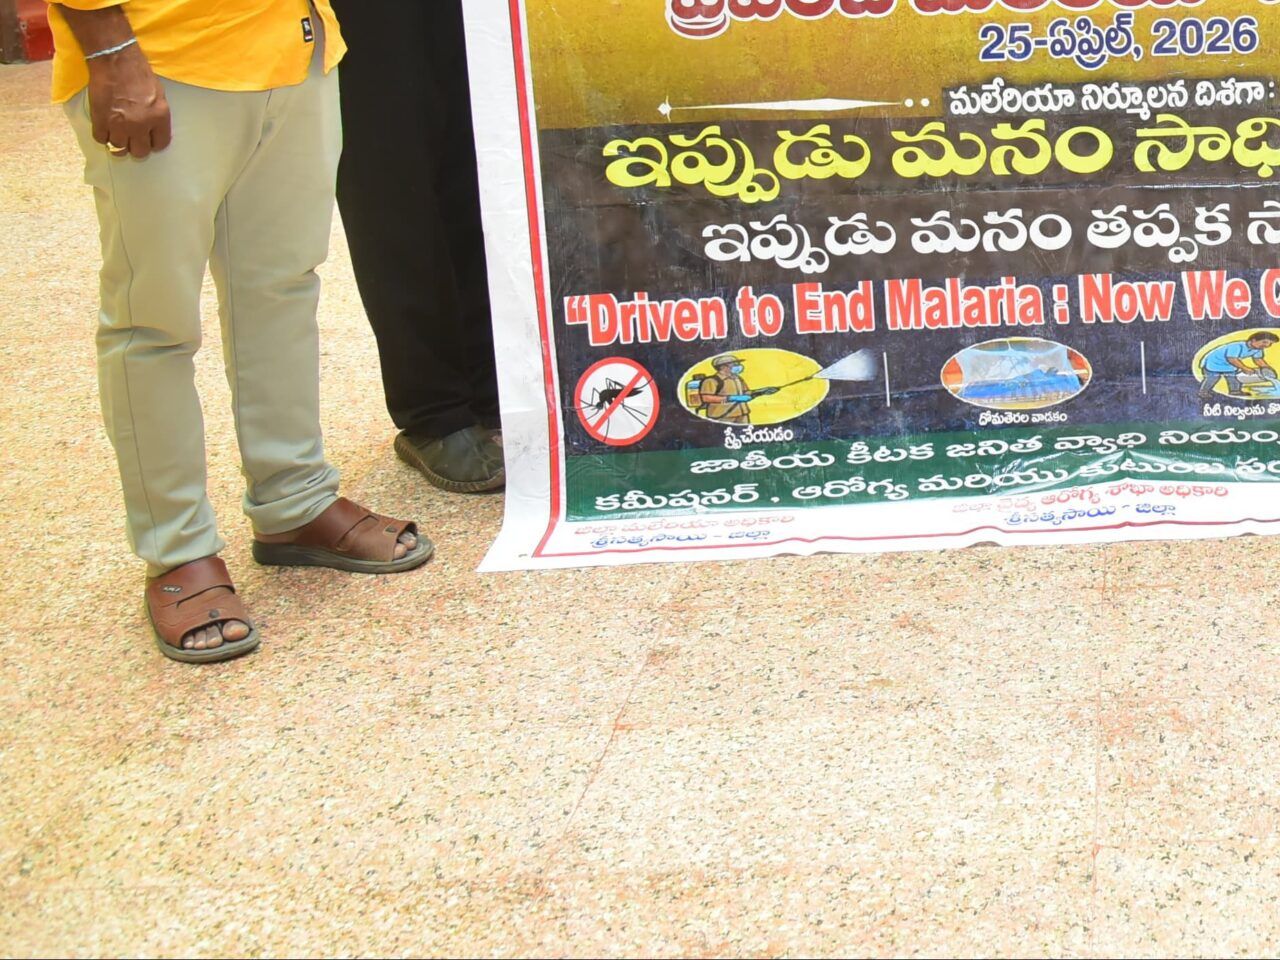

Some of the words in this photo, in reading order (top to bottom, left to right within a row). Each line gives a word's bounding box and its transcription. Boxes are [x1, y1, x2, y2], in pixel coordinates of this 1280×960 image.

[980, 13, 1142, 69] 25-ఏప్రిల్,
[1152, 16, 1258, 56] 2026
[950, 77, 1074, 115] మలేరియా
[1081, 79, 1188, 121] నిర్మూలన
[602, 123, 871, 204] ఇప్పుడు
[890, 118, 1115, 177] మనం
[701, 212, 896, 274] ఇప్పుడు
[910, 207, 1072, 255] మనం
[1087, 203, 1232, 263] తప్పక
[738, 286, 784, 337] to
[792, 280, 874, 334] End
[886, 274, 1044, 331] Malaria
[1078, 270, 1175, 323] Now
[1181, 268, 1251, 319] We
[979, 410, 1029, 426] దోమతెరల
[1031, 411, 1068, 422] వాడకం
[1223, 404, 1265, 420] నిల్వలను
[690, 449, 835, 474] జాతీయ
[847, 441, 934, 464] కీటక
[945, 435, 1043, 458] జనిత
[1055, 431, 1147, 454] వ్యాధి
[594, 483, 759, 512] కమీషనర్
[792, 477, 909, 501] ఆరోగ్య
[918, 467, 1068, 492] మరియు
[1079, 457, 1225, 478] కుటుంబ
[1040, 486, 1102, 506] ఆరోగ్య
[1159, 482, 1229, 499] అధికారి
